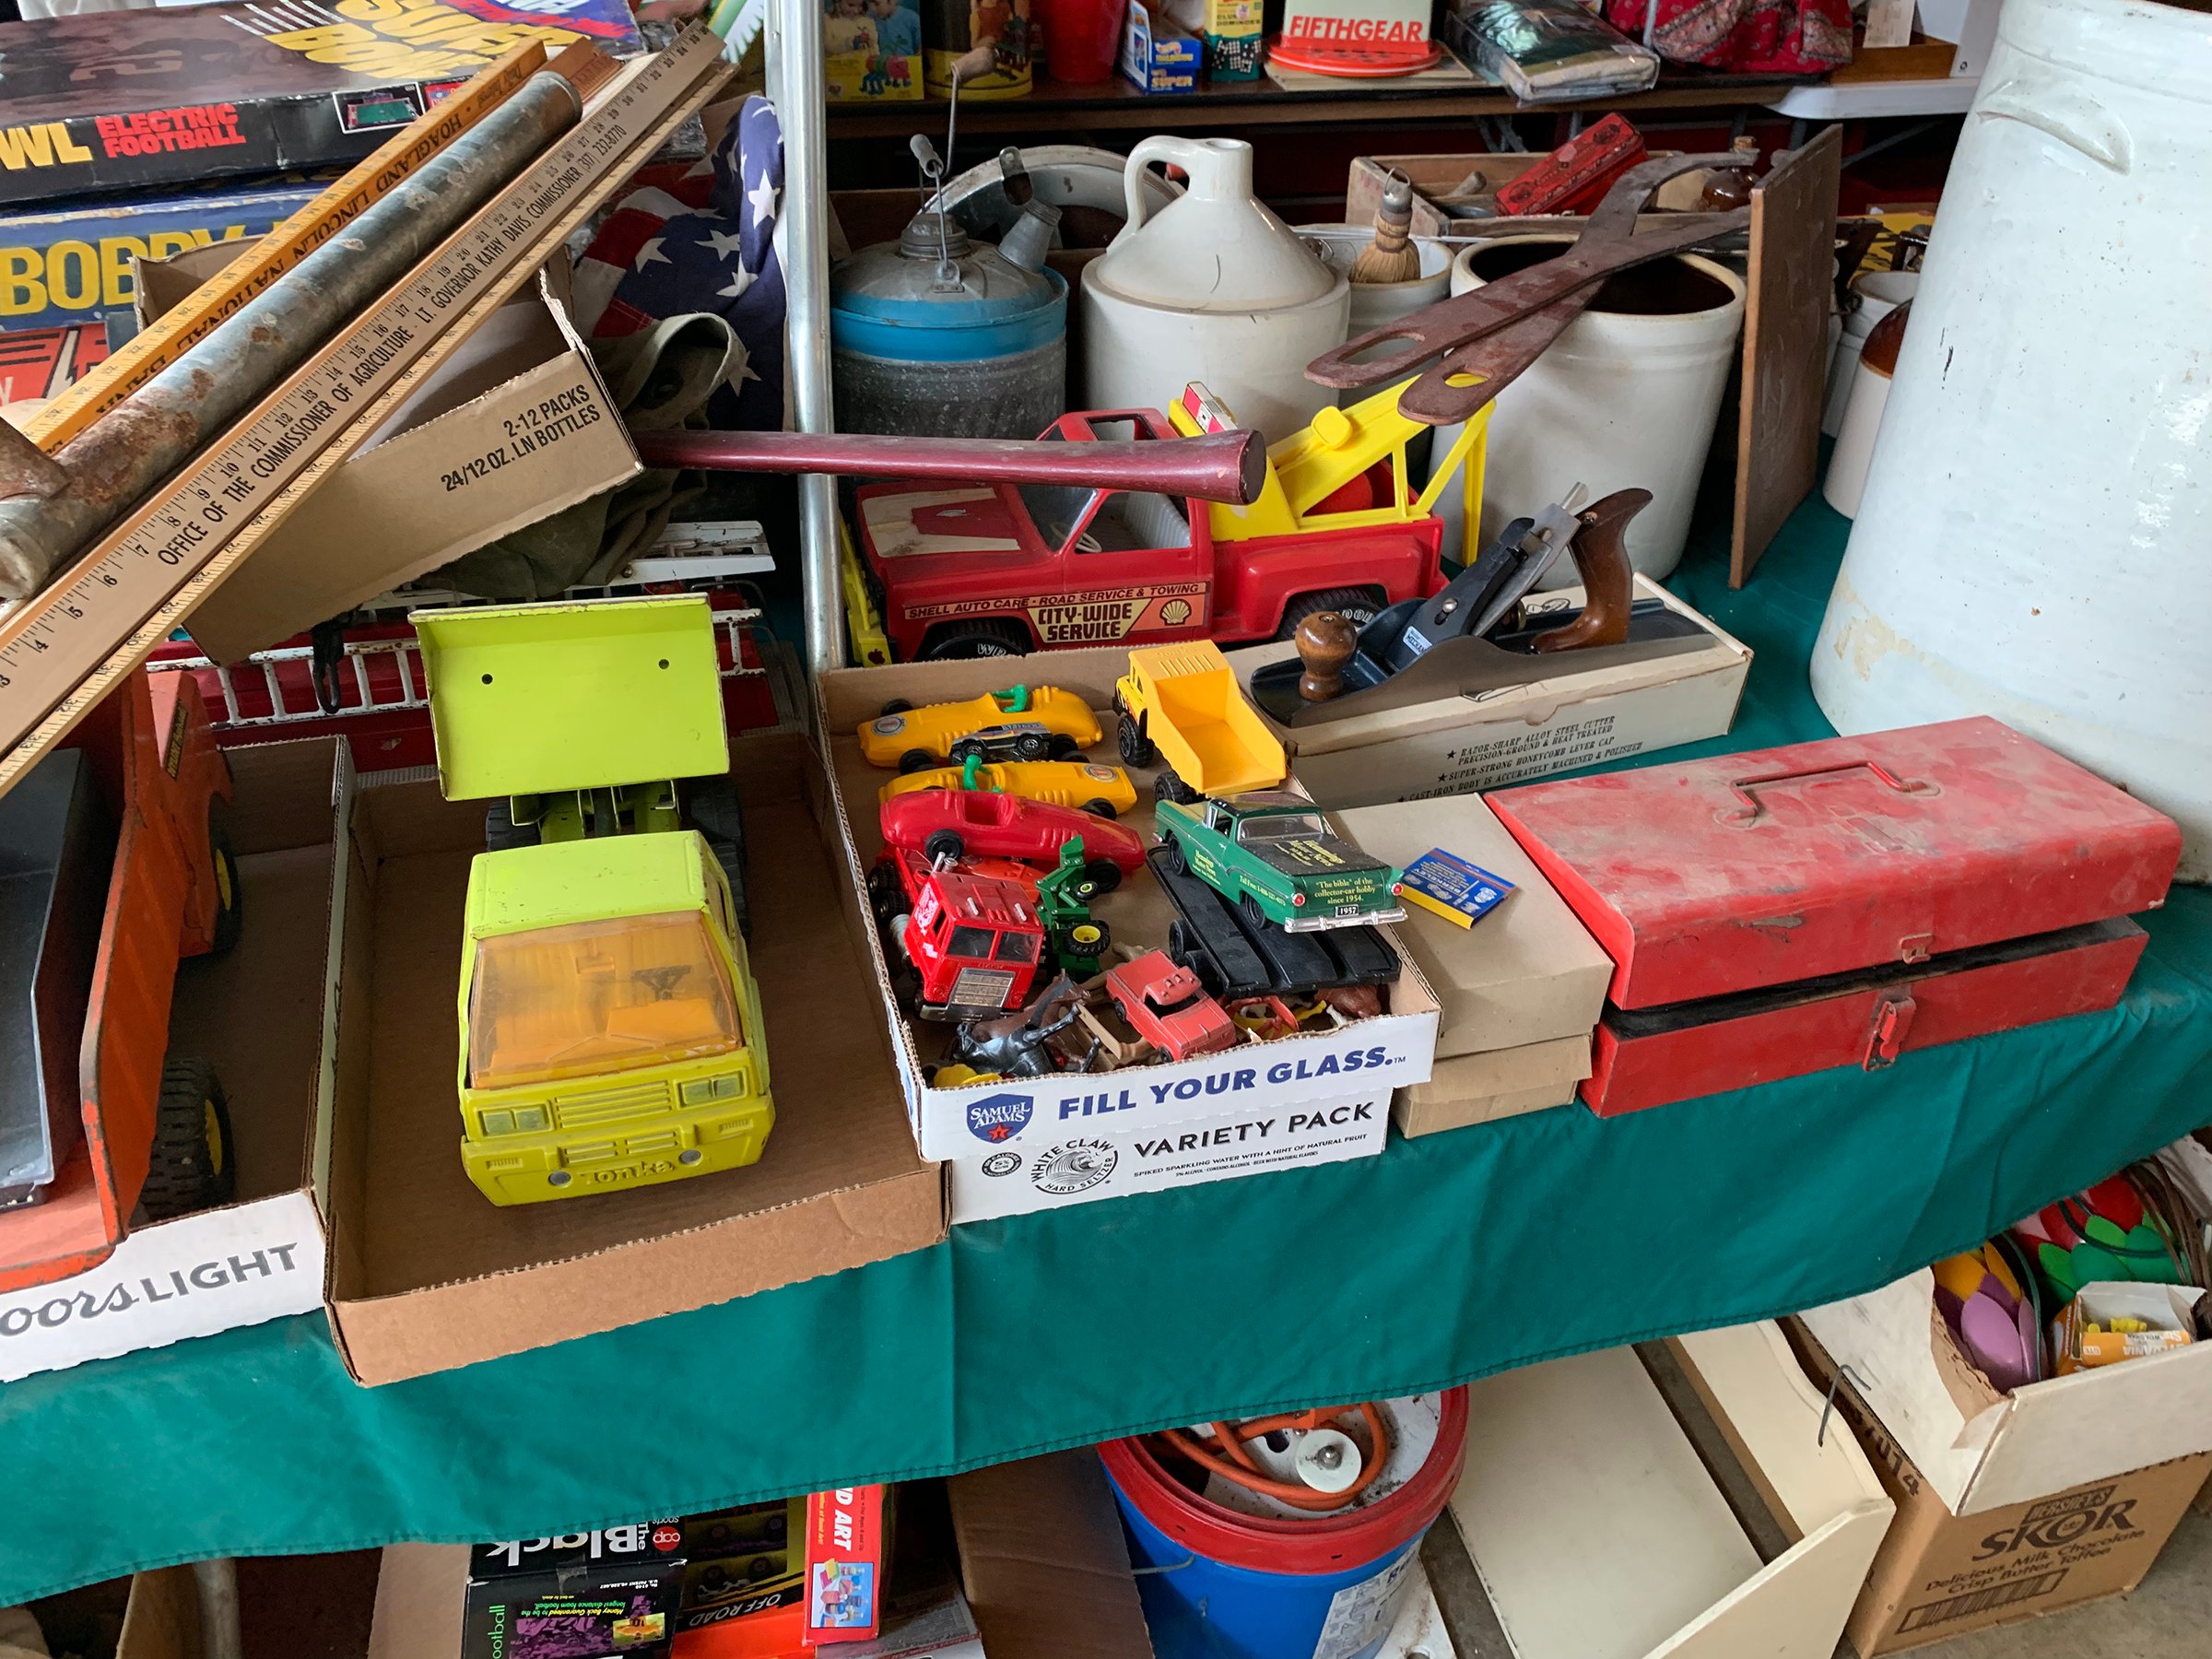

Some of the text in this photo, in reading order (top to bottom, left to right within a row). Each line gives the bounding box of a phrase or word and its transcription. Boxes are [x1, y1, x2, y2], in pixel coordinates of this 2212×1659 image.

[1290, 15, 1423, 42] FIFTHGEAR
[95, 102, 240, 138] ELECTRIC
[103, 124, 247, 159] FOOTBALL
[377, 114, 463, 194] HOAGLAND
[291, 191, 371, 258] LINCOLN
[158, 521, 208, 565] OFFICE
[203, 500, 229, 523] OF
[222, 477, 255, 502] THE
[250, 398, 337, 478] COMMISSIONER
[332, 382, 354, 402] OF
[349, 324, 415, 387] AGRICULTURE
[415, 303, 437, 324] LT.
[431, 263, 482, 309] GOVERNOR
[476, 238, 507, 267] KATHY
[502, 212, 535, 241] DAVIS,
[526, 167, 583, 220] COMMISSIONER
[593, 124, 627, 157] 232-8770
[503, 383, 590, 438] 2-12 PACKS
[441, 403, 601, 492] 24/12 OZ. LN BOTTLES
[35, 345, 366, 651] 4 5 6 7 8 9 10 11 12 13 14 15
[909, 582, 1198, 618] SHELL AUTO CARE ROAD SERVICE & TOWING
[1038, 601, 1133, 625] CITY-WIDE
[1046, 620, 1122, 641] SERVICE
[1458, 741, 1540, 766] PRECISION-GROUND
[1552, 735, 1572, 746] HEAT
[1577, 724, 1613, 739] TREATED
[1461, 715, 1616, 757] RAZOR-SHARP ALLOY STEEL CUTTER
[1448, 736, 1615, 782] SUPER-STRONG HONEYCOMB LEVER CAP
[1457, 779, 1481, 792] BODY
[1484, 777, 1492, 785] IS
[1495, 763, 1548, 783] ACCURATELY
[1551, 754, 1594, 770] MACHINED
[1605, 741, 1644, 759] POLISHED
[1314, 885, 1376, 898] collector-car hobby
[1327, 894, 1364, 904] since 1954.
[1412, 868, 1462, 894] BERKELEY
[1340, 906, 1358, 914] 1957
[1059, 1045, 1394, 1121] FILL YOUR GLASS.
[970, 1101, 1031, 1122] SAMUEL
[973, 1112, 1026, 1129] ADAMS
[1134, 1100, 1375, 1158] VARIETY PACK
[579, 1159, 676, 1184] Tonka
[1030, 1145, 1065, 1182] WHITE
[1065, 1138, 1115, 1152] CLAW
[1044, 1157, 1115, 1192] HARD SELTZER
[1134, 1167, 1164, 1178] SPIKED
[1165, 1159, 1211, 1172] SPARKLING
[1212, 1154, 1241, 1164] WATER
[1241, 1150, 1265, 1160] WITH
[1273, 1147, 1293, 1157] HINT
[1293, 1145, 1307, 1153] OF
[1307, 1137, 1344, 1151] NATURAL
[1345, 1134, 1368, 1143] FRUIT
[140, 1242, 298, 1303] LIGHT
[0, 1282, 140, 1336] oors
[2030, 1486, 2111, 1519] HERSHEY'S
[485, 1521, 647, 1567] The Black
[833, 1508, 853, 1552] ART
[1972, 1499, 2138, 1561] SKOR
[1925, 1530, 2146, 1592] Delicious Milk Chocolate
[1947, 1547, 2112, 1595] Crisp Butter Toffee
[520, 1609, 533, 1618] the
[549, 1608, 587, 1618] Guaranteed
[559, 1601, 578, 1610] foam
[578, 1601, 604, 1609] distance
[602, 1607, 625, 1616] Money
[604, 1600, 626, 1609] longest
[688, 1593, 782, 1627] OFF ROAD
[487, 1604, 506, 1659] ootball
